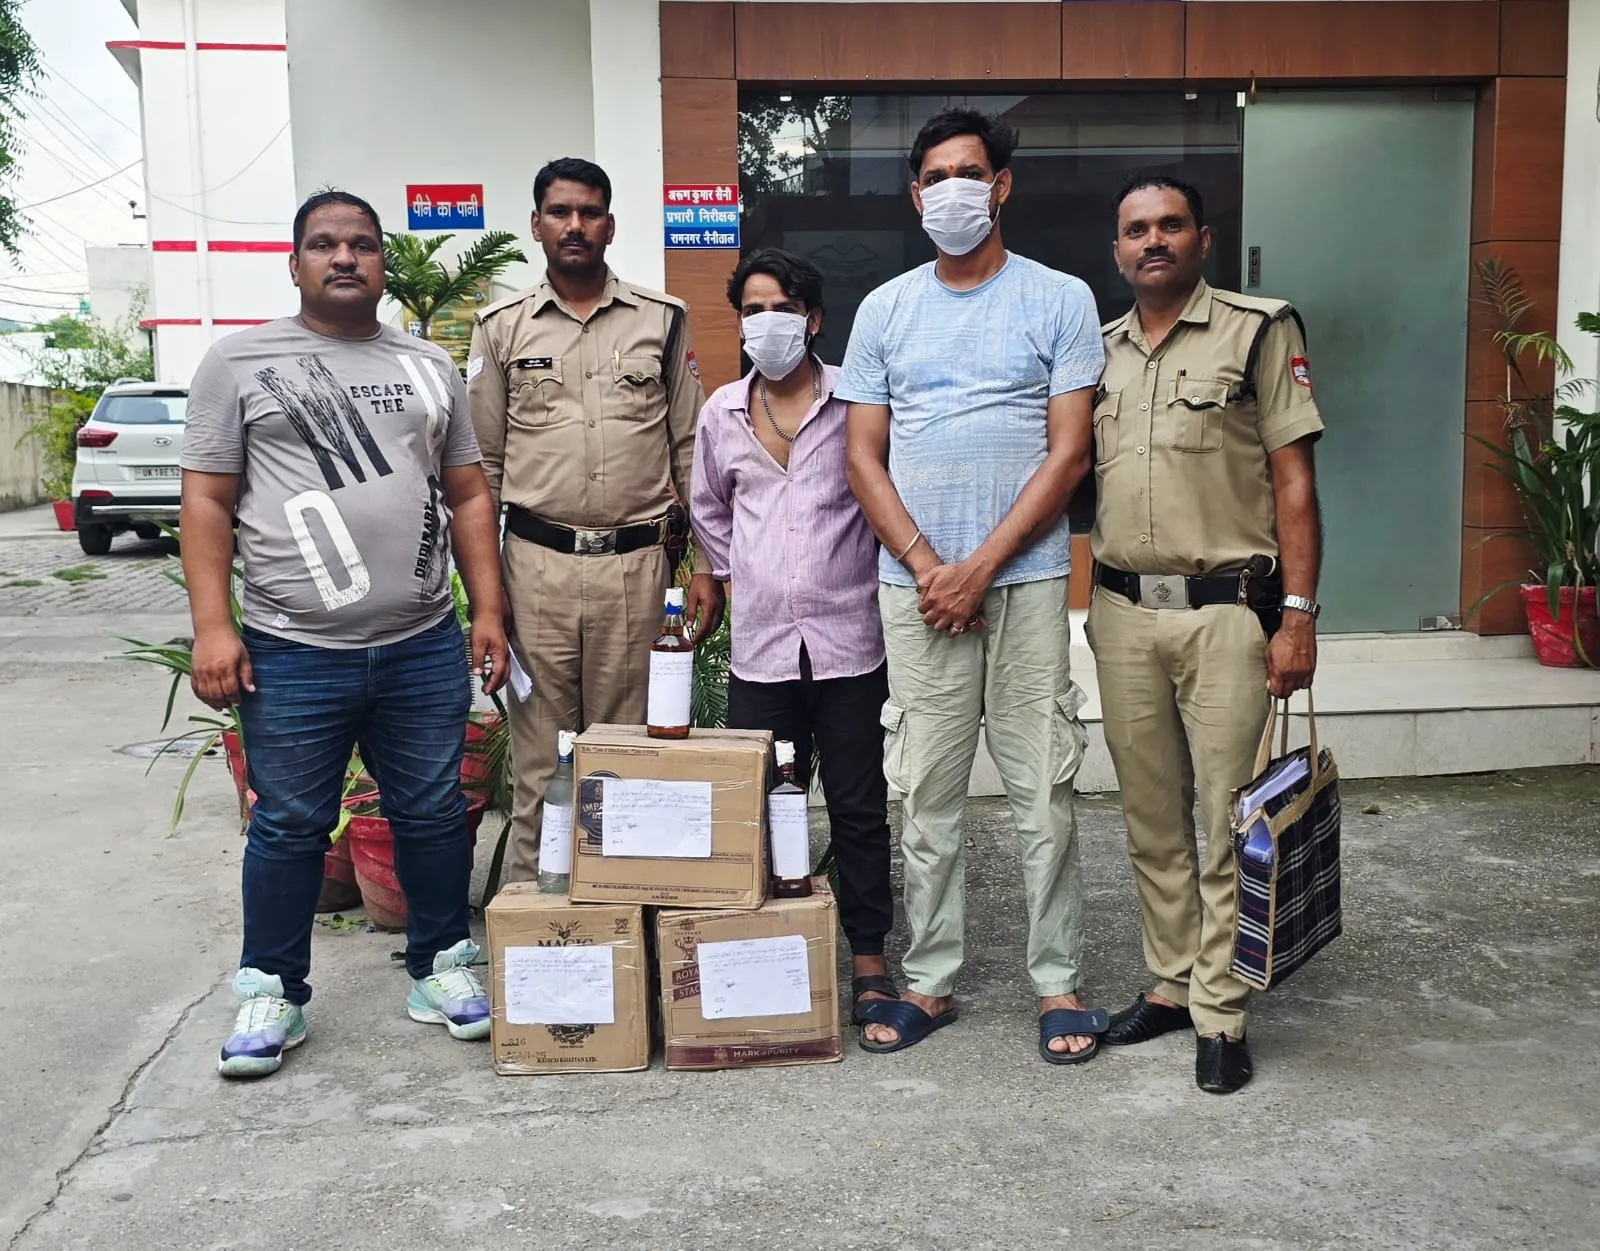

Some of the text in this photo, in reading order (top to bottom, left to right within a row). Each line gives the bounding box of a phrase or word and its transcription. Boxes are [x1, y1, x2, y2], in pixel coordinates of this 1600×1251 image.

[692, 189, 714, 204] कुमार
[715, 186, 732, 201] सैनी
[412, 193, 479, 217] पीने का पानी
[665, 207, 737, 223] प्रभारी निरीक्षक
[669, 229, 735, 245] रामनगर नैनीताल
[350, 383, 415, 399] ESCAPE
[370, 398, 405, 414] THE
[733, 1049, 760, 1058] MARK
[767, 1047, 800, 1056] PURITY
